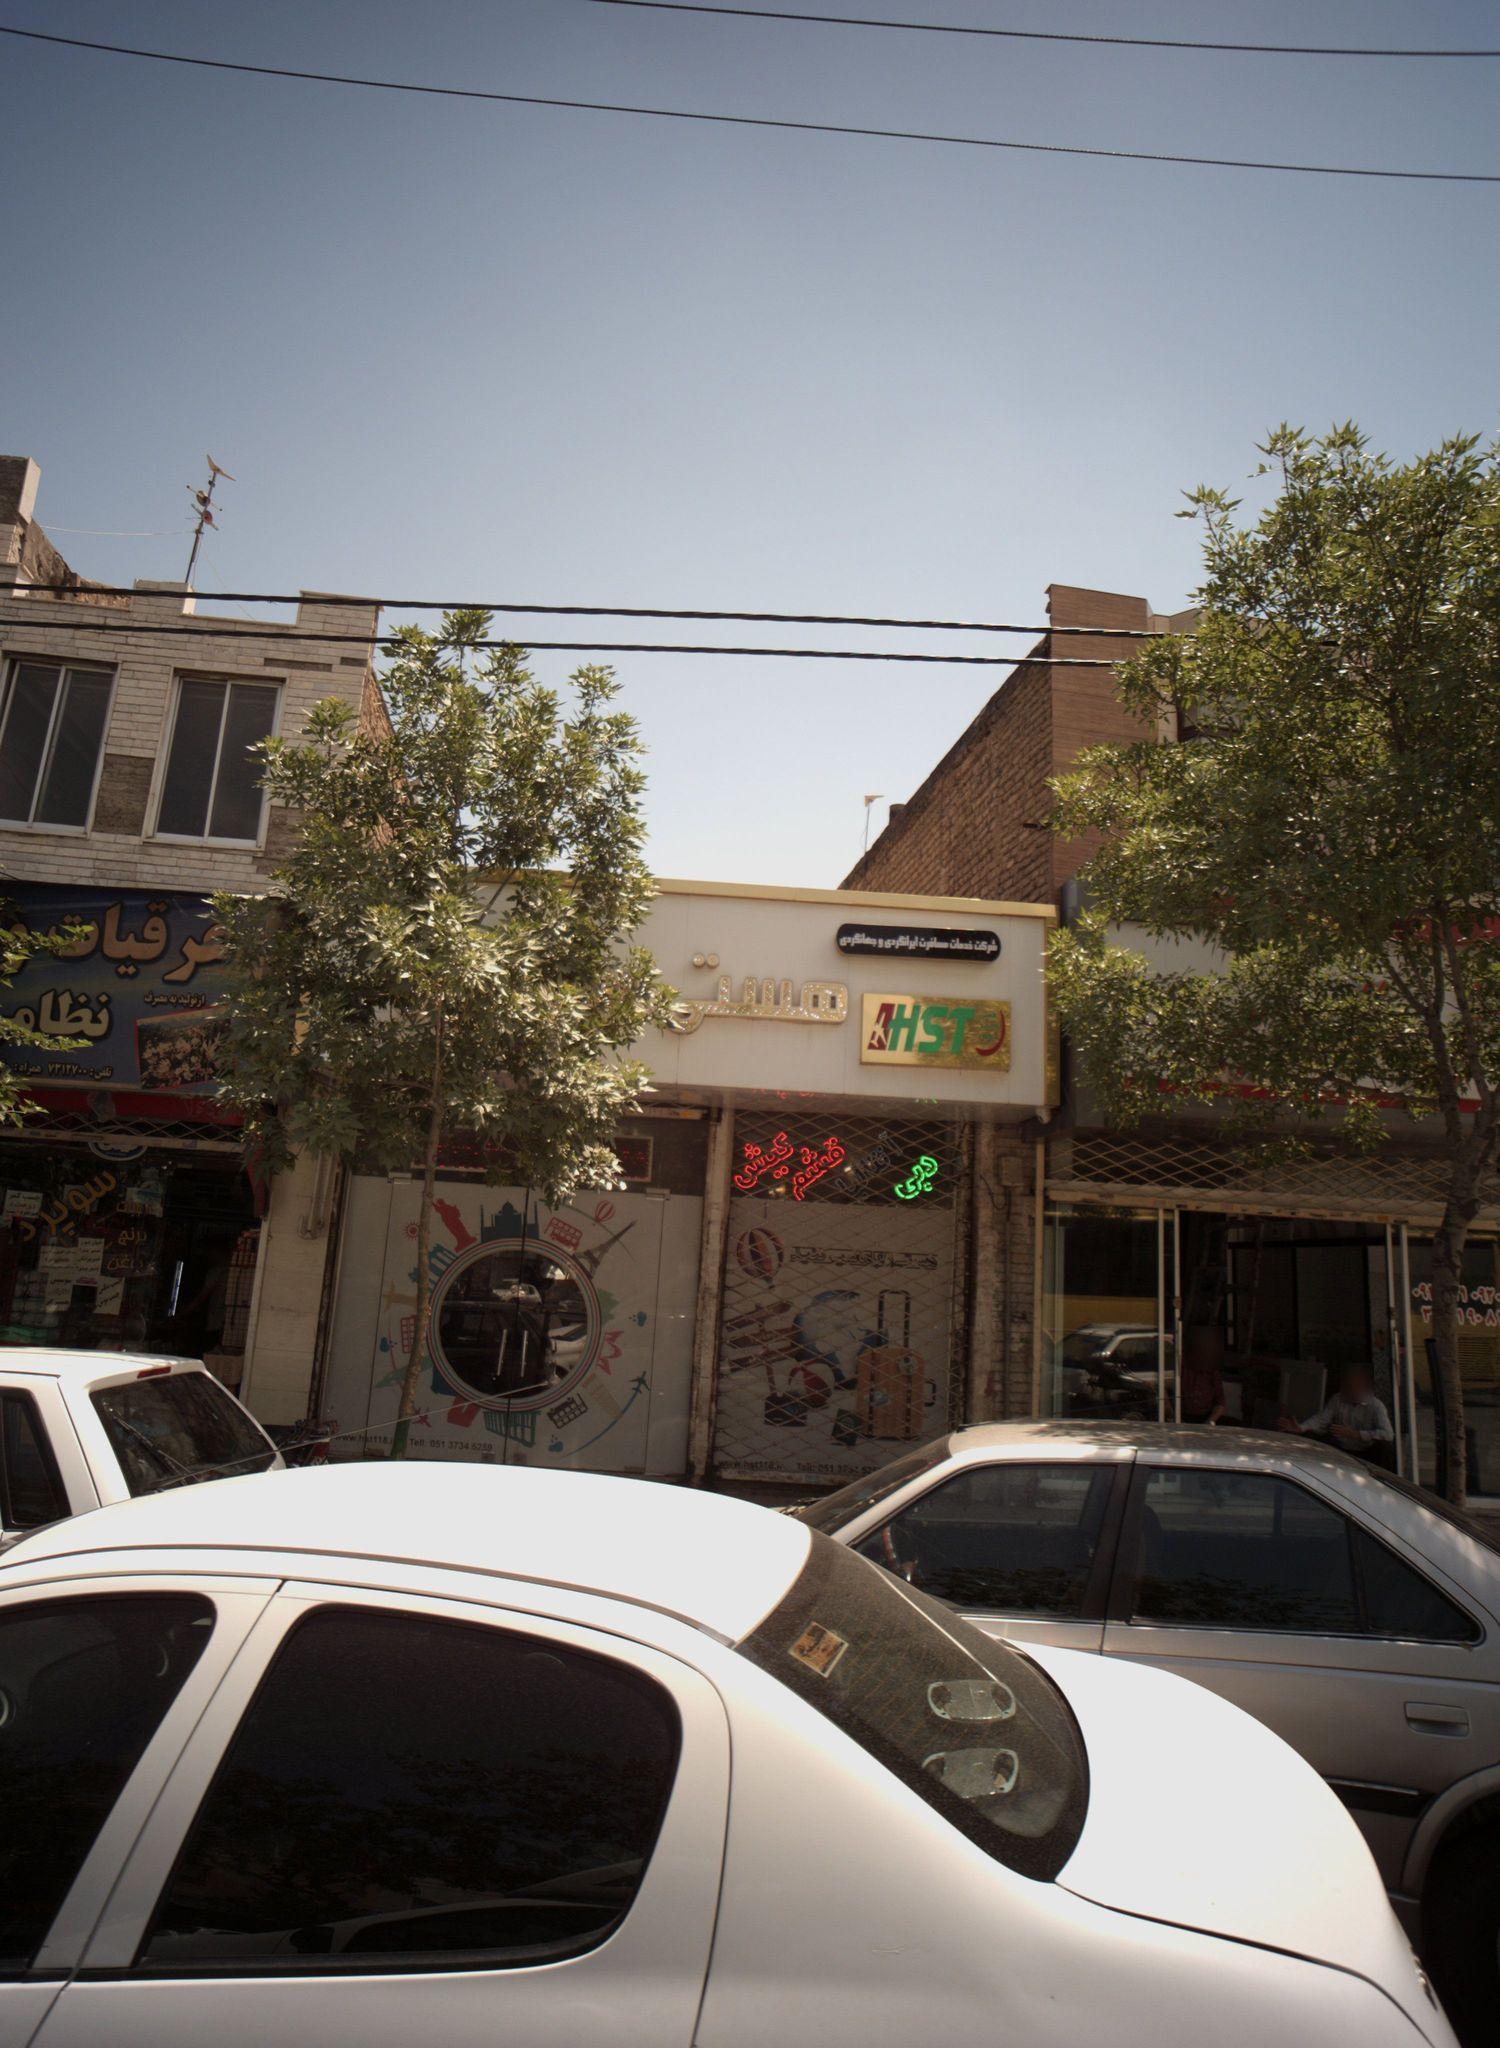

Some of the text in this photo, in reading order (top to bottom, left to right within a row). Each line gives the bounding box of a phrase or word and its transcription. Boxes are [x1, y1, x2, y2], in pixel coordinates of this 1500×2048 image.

[839, 932, 877, 947] جهانگردی
[878, 938, 884, 949] و
[884, 935, 919, 950] ایرانگردی
[950, 938, 973, 950] خدمات
[974, 938, 998, 954] شرکت
